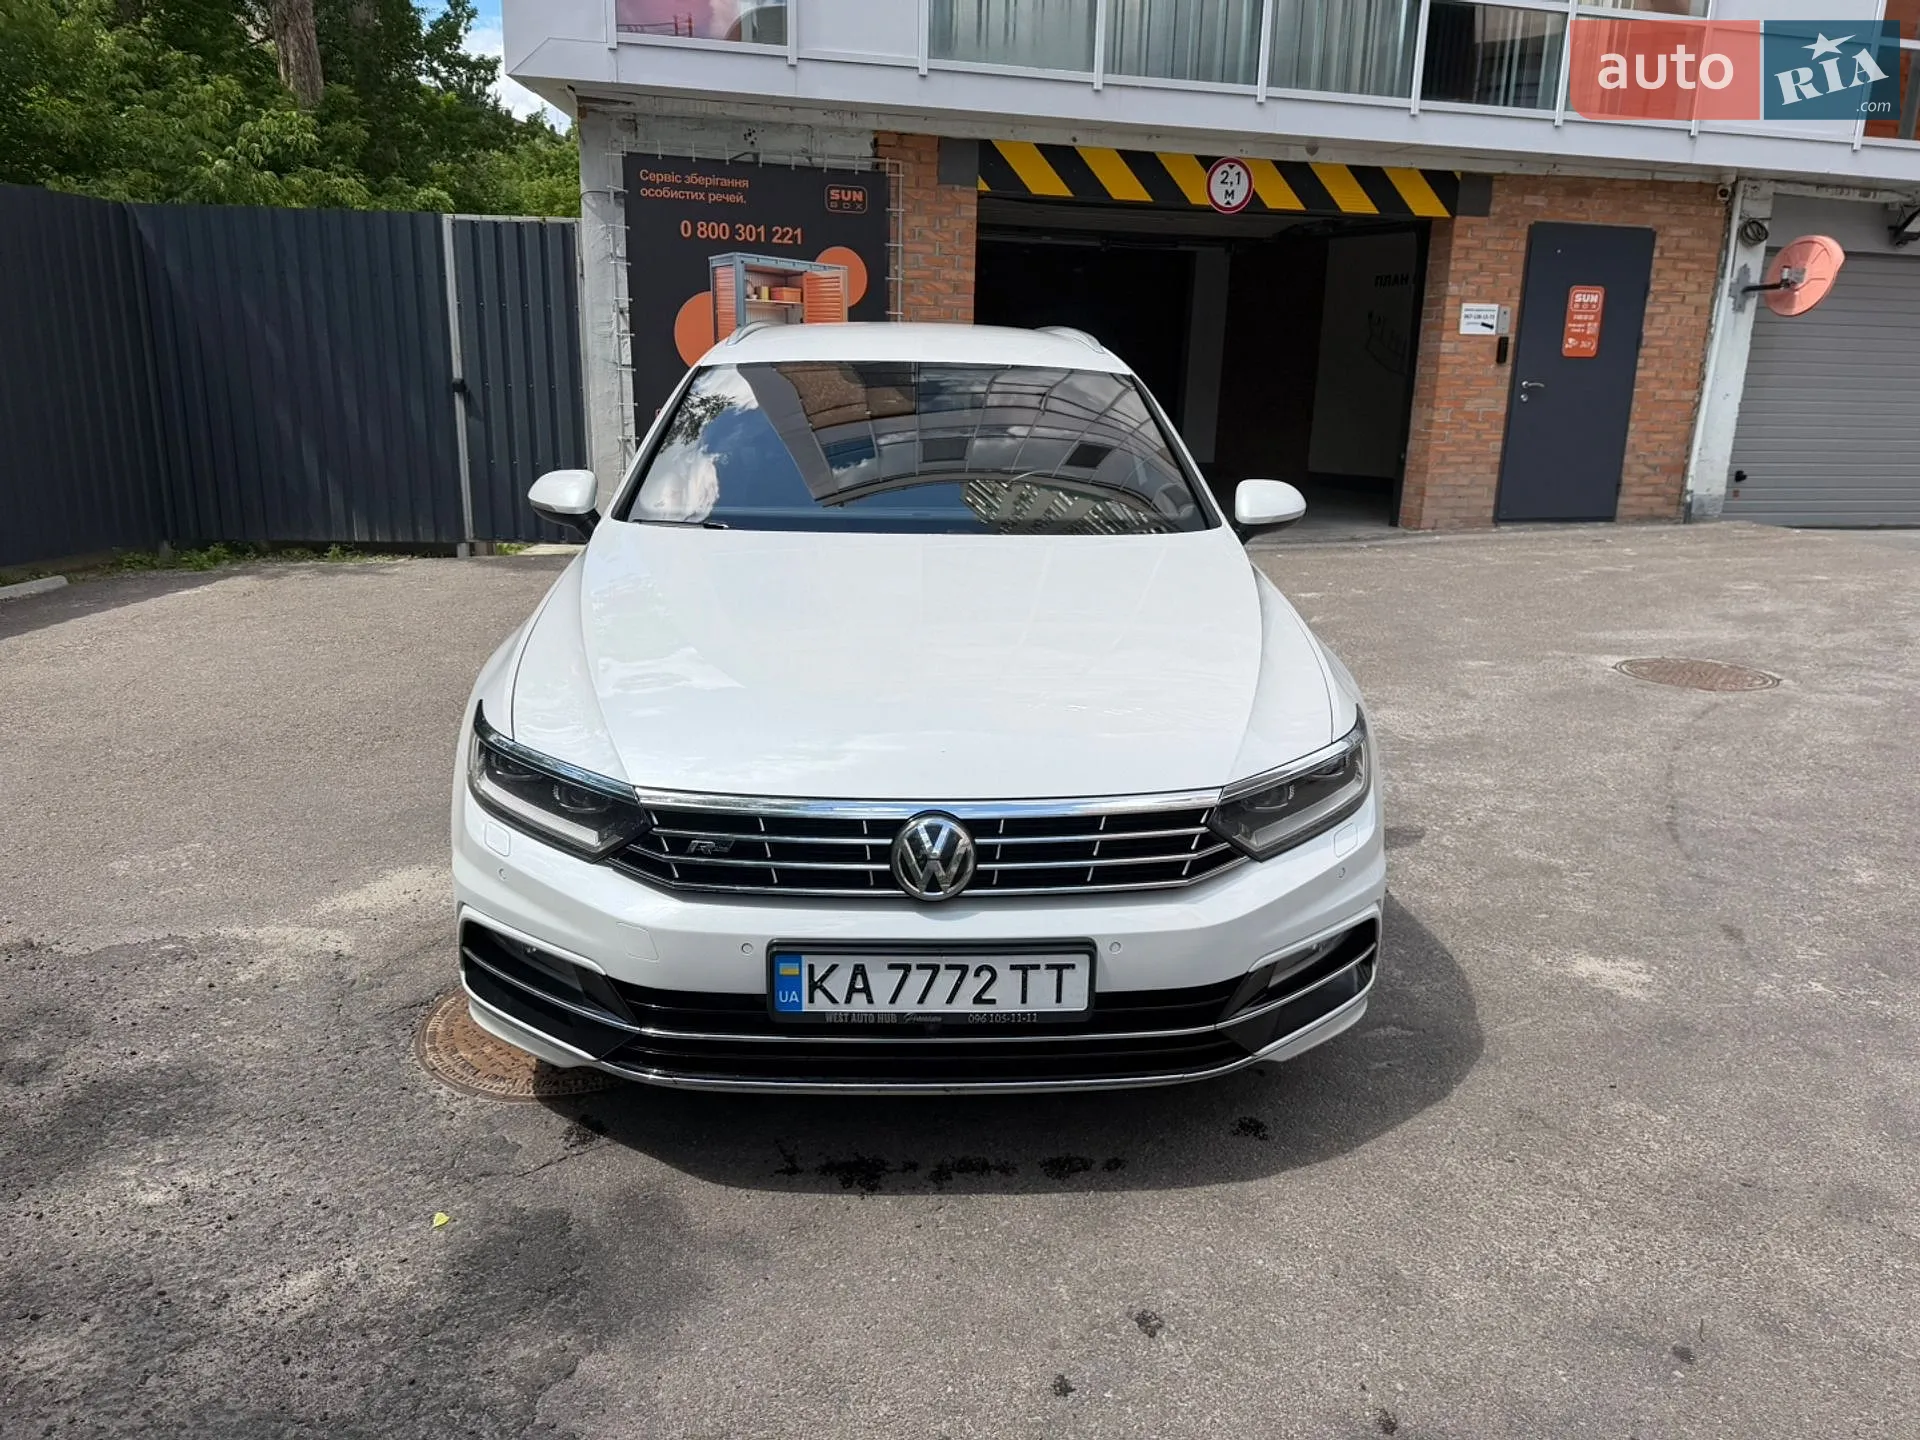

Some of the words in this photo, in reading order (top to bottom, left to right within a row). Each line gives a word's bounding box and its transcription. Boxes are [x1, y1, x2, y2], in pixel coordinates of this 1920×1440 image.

[639, 169, 682, 184] Сервіс
[684, 173, 749, 189] зберігання
[1220, 170, 1241, 187] 2,1
[640, 187, 706, 201] особистих
[708, 192, 747, 204] речей.
[830, 190, 864, 202] SUN
[680, 220, 692, 238] 0
[697, 221, 730, 239] 800
[735, 223, 766, 242] 301
[771, 226, 802, 245] 221
[1574, 293, 1598, 303] SUN
[808, 963, 874, 1005] KA
[887, 963, 998, 1005] 7772
[1009, 963, 1076, 1005] TT
[779, 990, 800, 1004] UA
[825, 1012, 849, 1023] WEST
[851, 1012, 875, 1023] AUTO
[877, 1012, 898, 1023] HUB
